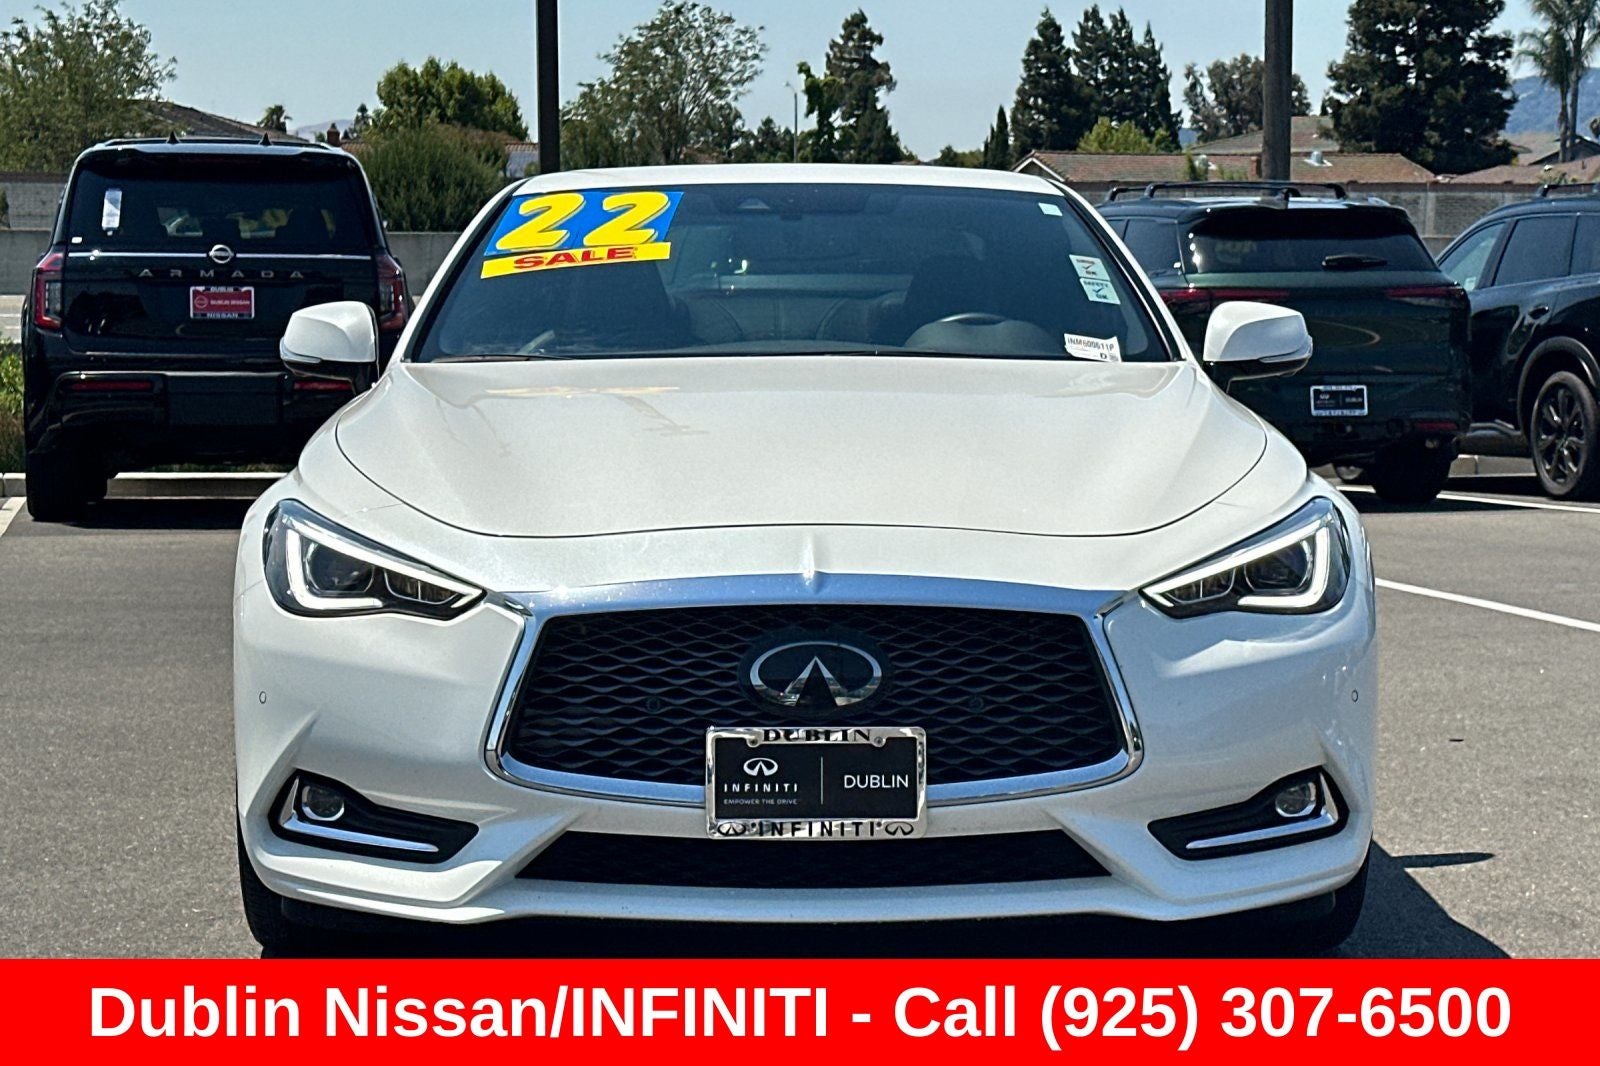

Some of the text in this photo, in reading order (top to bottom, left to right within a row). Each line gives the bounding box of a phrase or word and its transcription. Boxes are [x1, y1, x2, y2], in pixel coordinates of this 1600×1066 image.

[496, 192, 671, 252] 22
[514, 246, 638, 270] SALE
[138, 268, 304, 279] ARMADA
[763, 728, 871, 742] DUBLIN
[723, 783, 798, 793] INFINITI
[844, 774, 909, 789] DUBLIN
[758, 821, 875, 837] INFINITI
